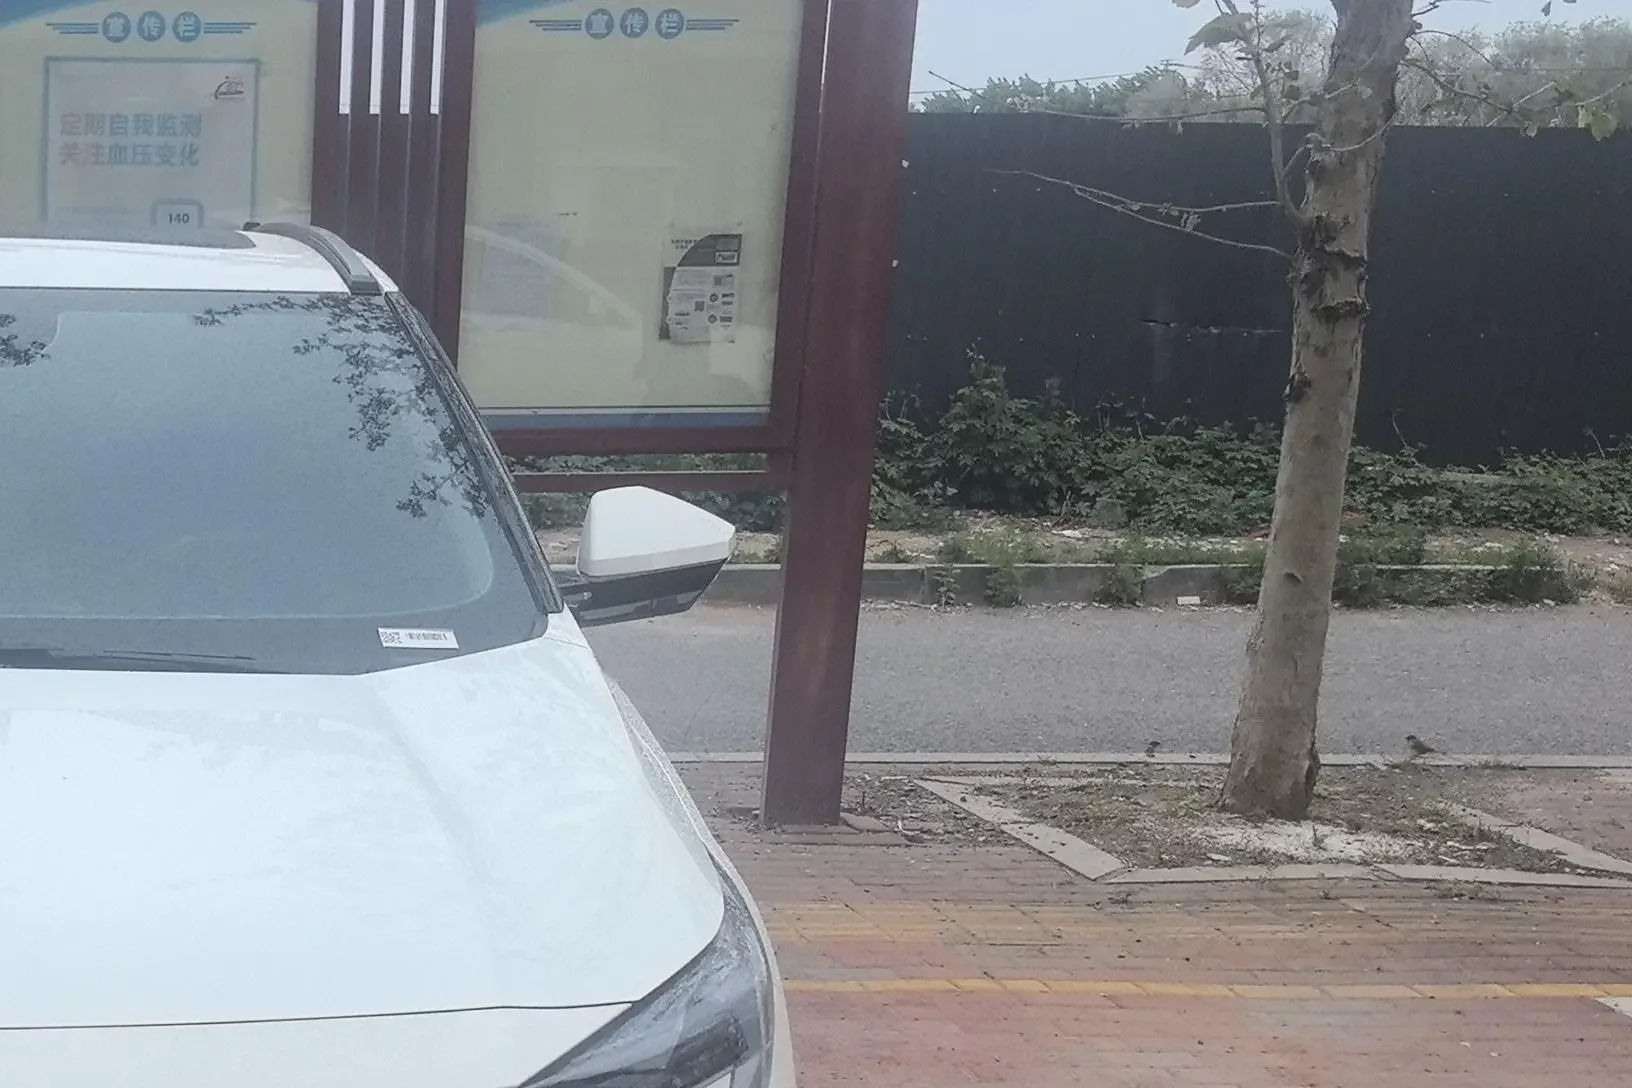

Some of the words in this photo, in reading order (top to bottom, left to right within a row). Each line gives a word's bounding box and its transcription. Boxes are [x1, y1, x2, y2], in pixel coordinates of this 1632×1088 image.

[59, 112, 203, 138] 定期自我监测
[59, 142, 200, 167] 关注血压变化
[167, 213, 190, 225] 140
